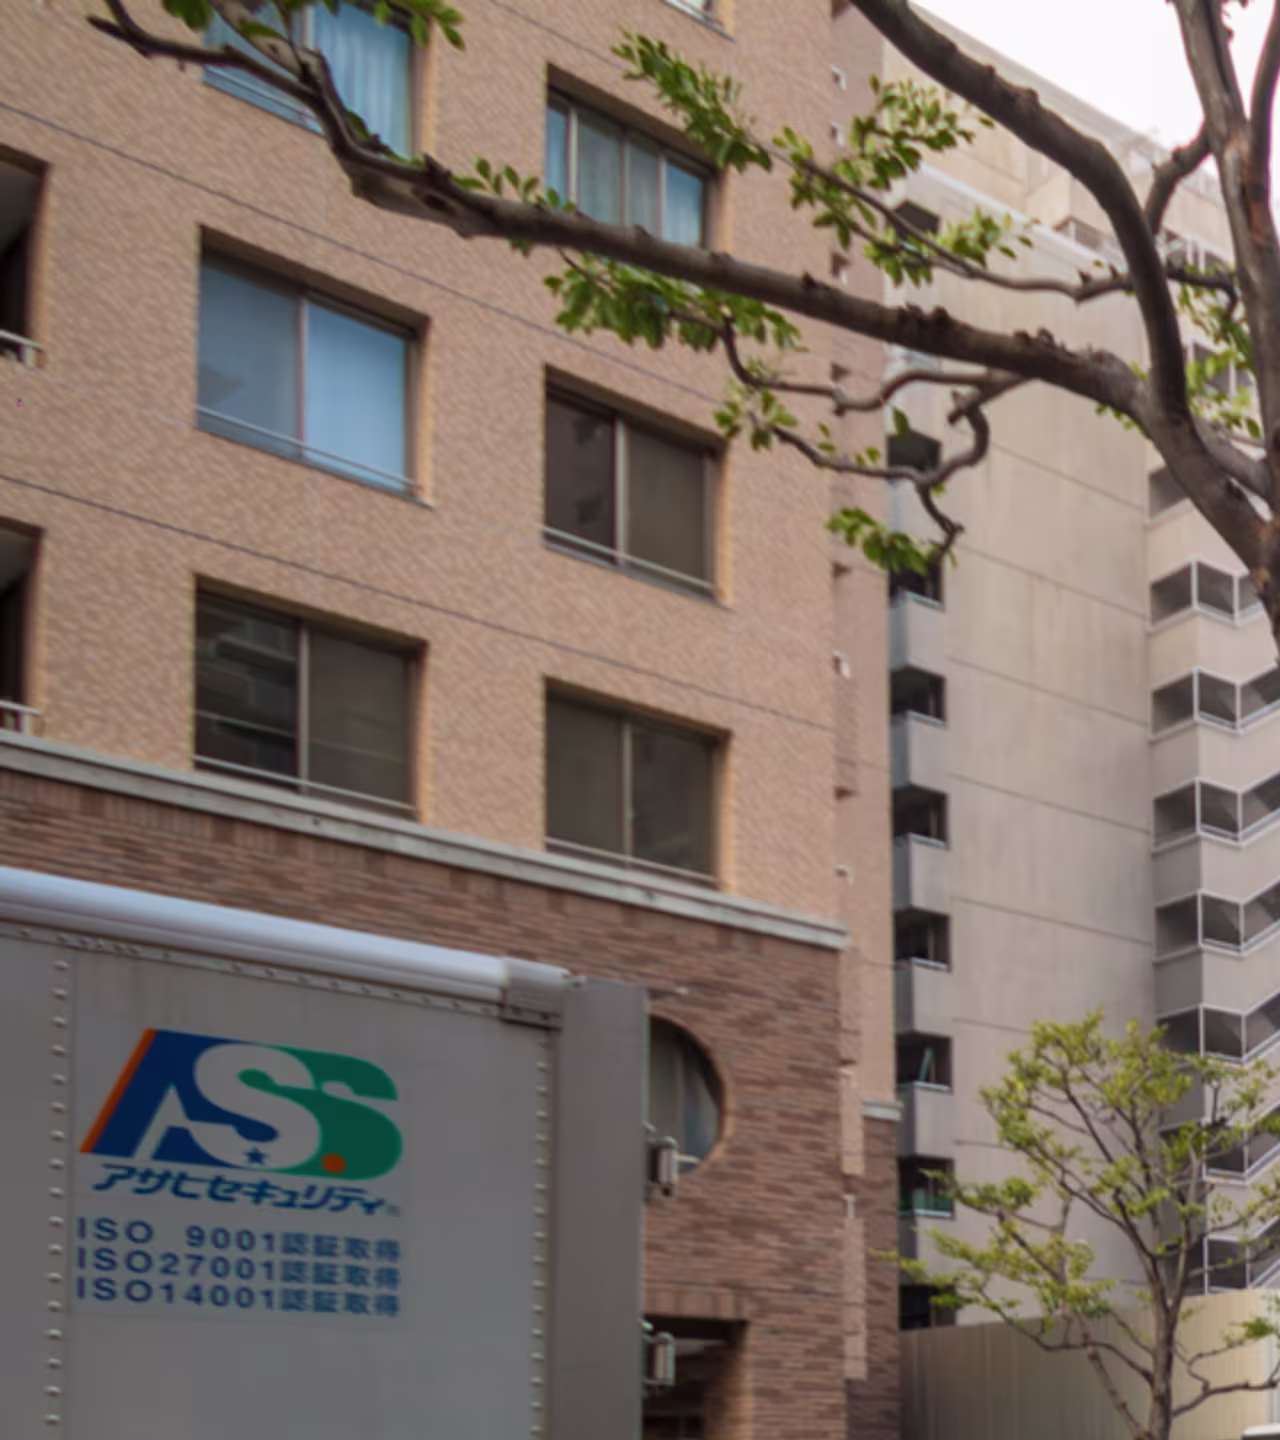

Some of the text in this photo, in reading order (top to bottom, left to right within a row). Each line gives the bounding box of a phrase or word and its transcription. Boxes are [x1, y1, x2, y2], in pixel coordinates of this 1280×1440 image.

[92, 1162, 386, 1217] アサヒセキュリティ
[76, 1216, 154, 1245] ISO
